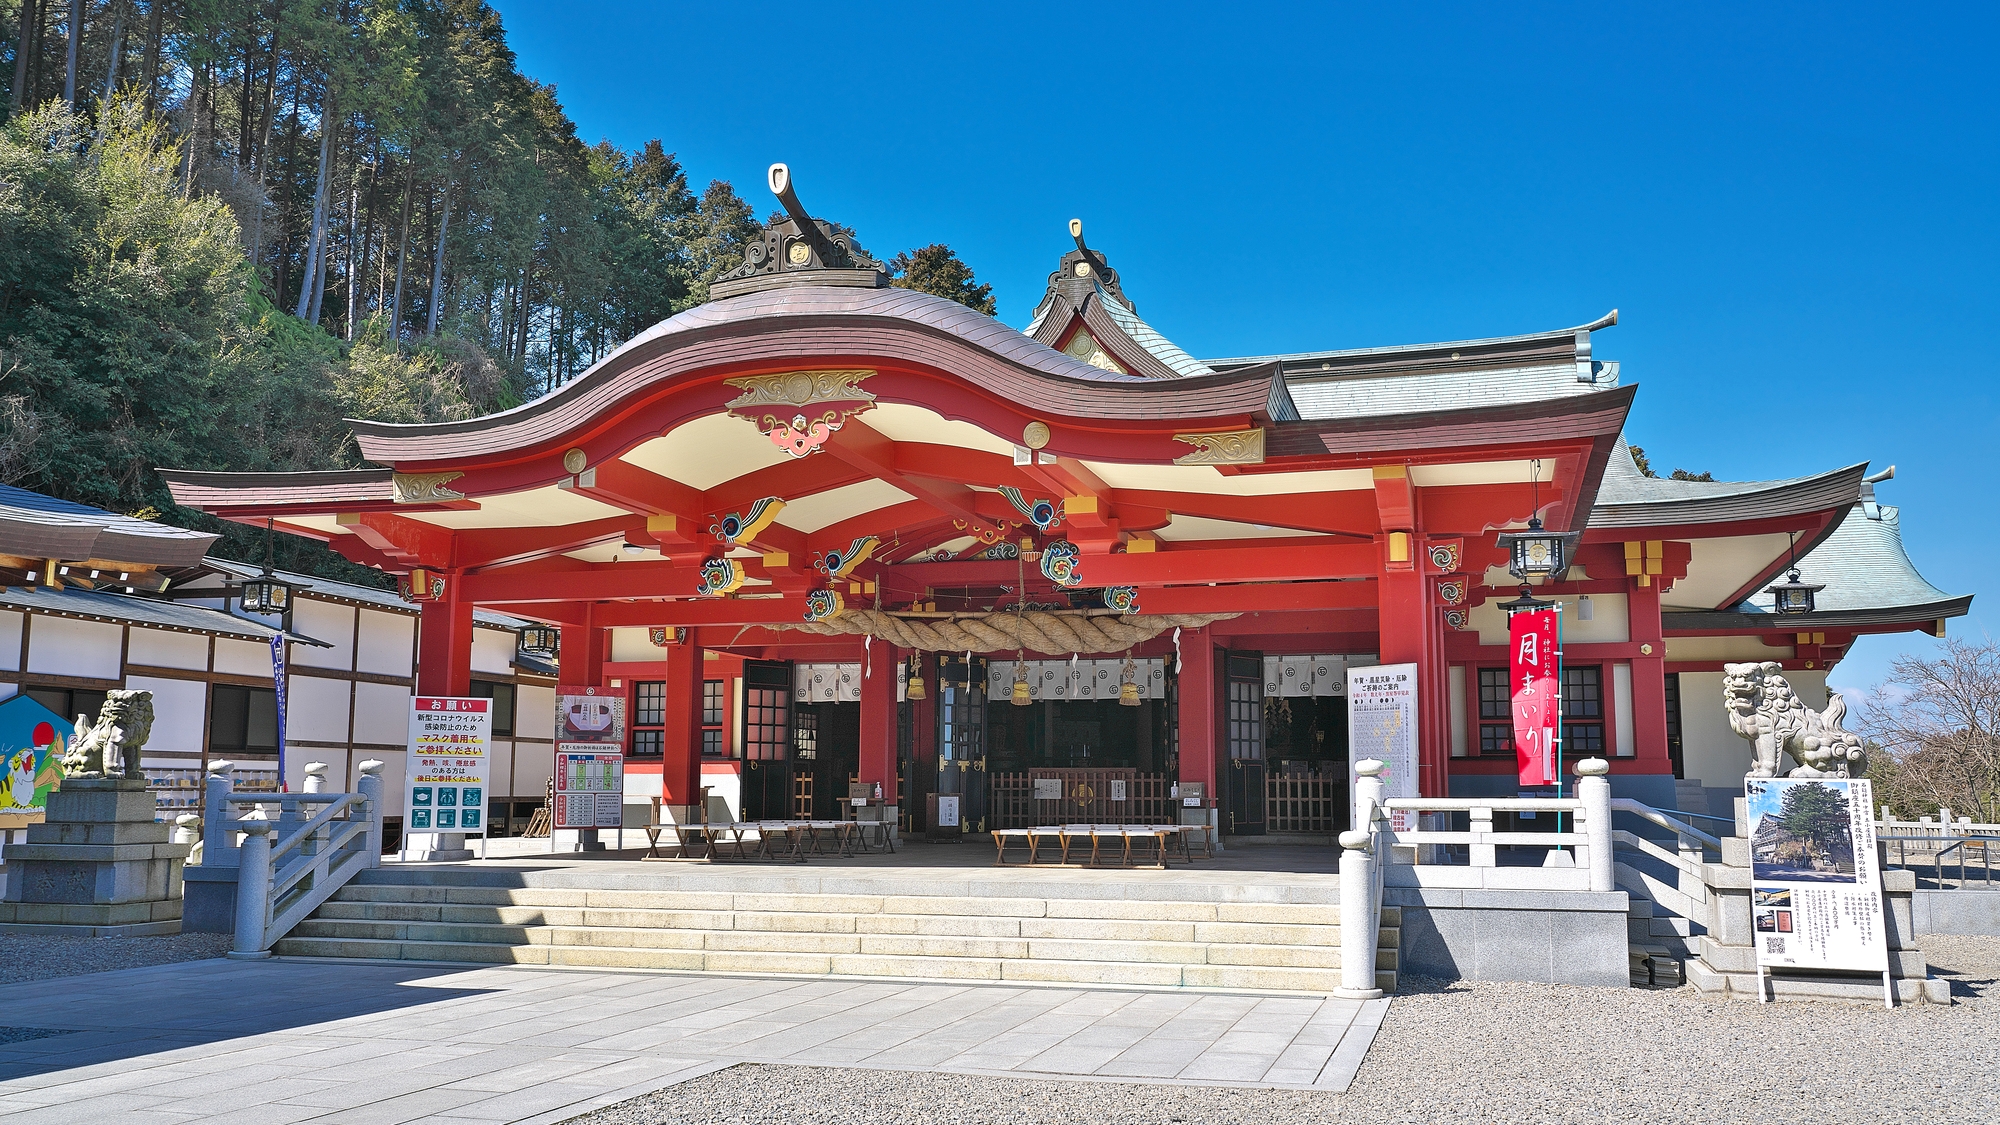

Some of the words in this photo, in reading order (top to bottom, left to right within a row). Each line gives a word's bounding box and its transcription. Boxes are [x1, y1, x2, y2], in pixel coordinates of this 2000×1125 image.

[1518, 632, 1538, 755] 月まいり
[431, 700, 472, 710] お願い
[418, 714, 484, 722] 新型コロナウイルス
[422, 734, 477, 743] マスク着用で
[417, 745, 482, 755] ご参拝ください
